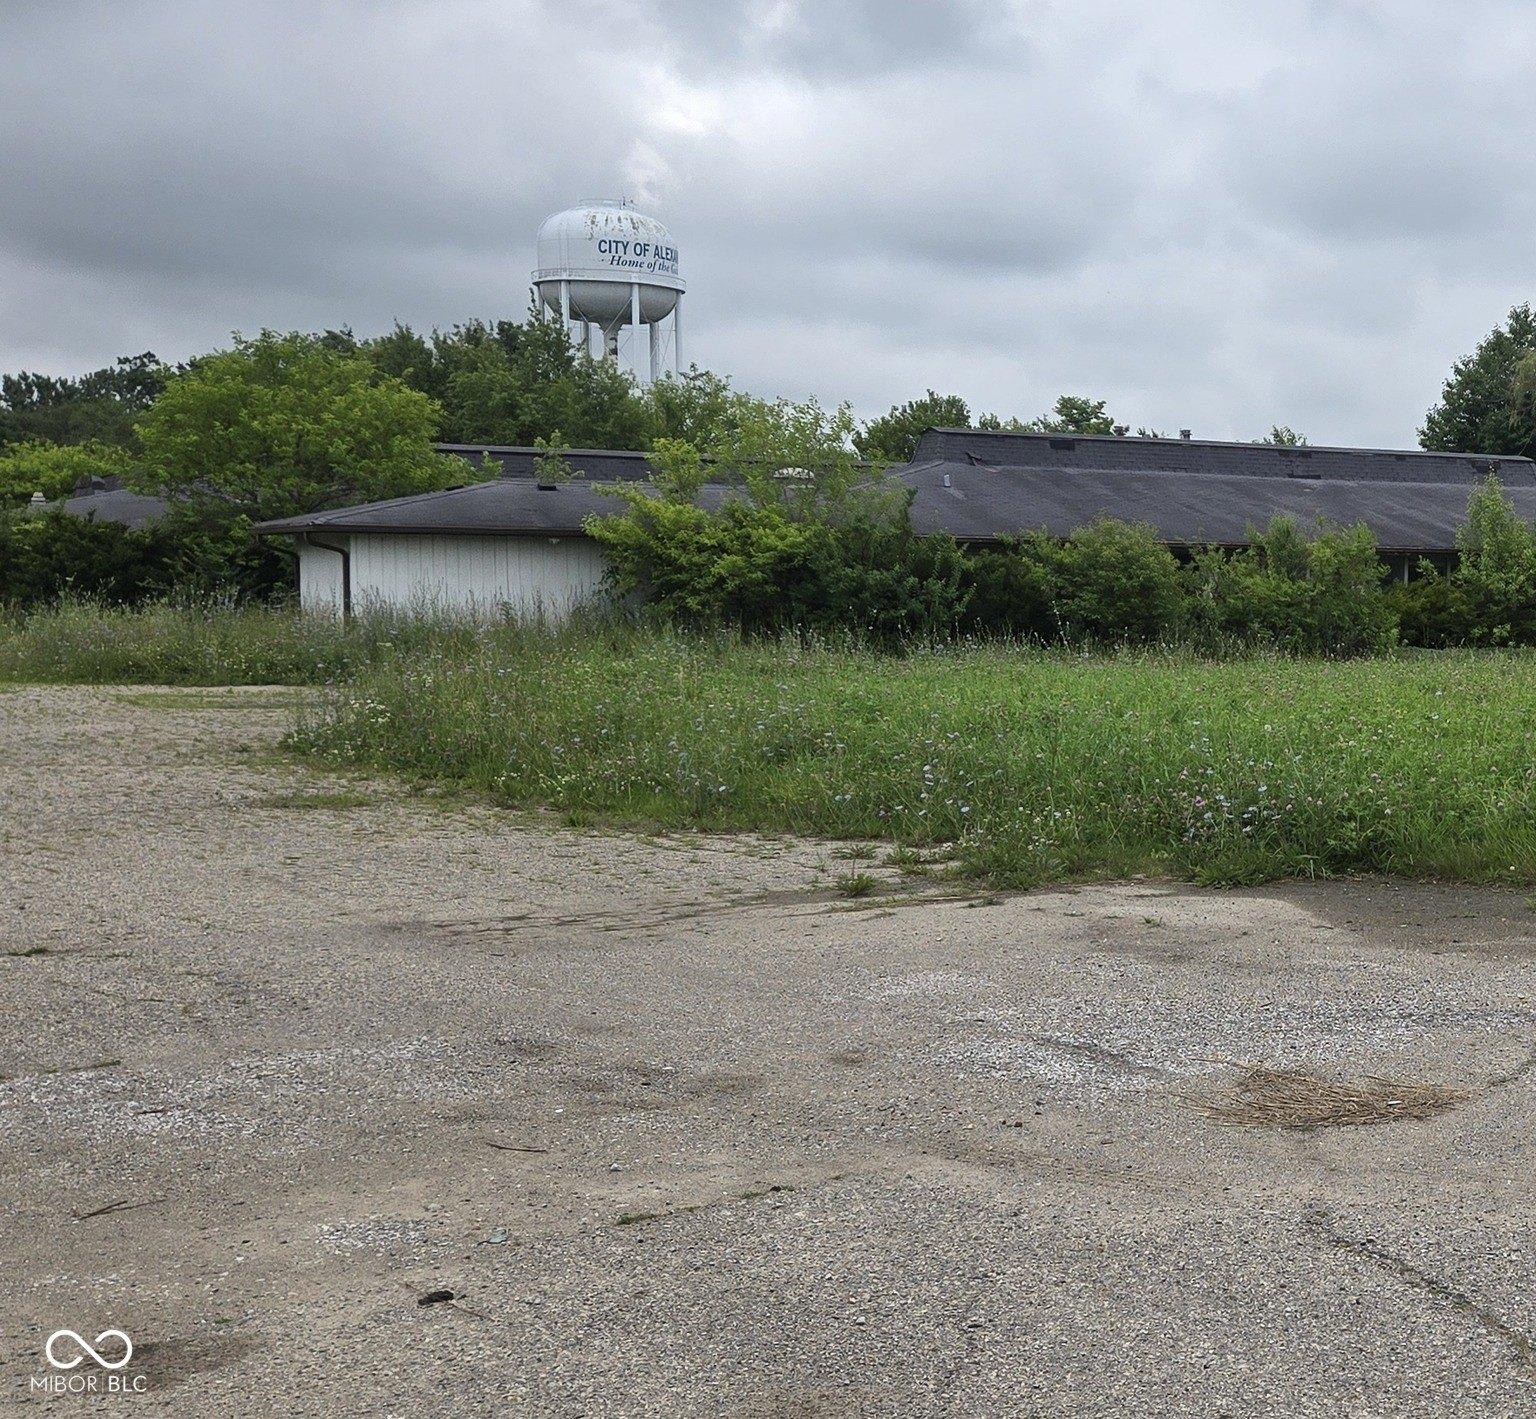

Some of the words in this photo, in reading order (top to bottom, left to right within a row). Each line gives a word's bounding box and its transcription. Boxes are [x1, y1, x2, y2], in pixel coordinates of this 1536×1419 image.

[598, 239, 630, 255] CITY
[633, 242, 650, 257] OF
[610, 255, 645, 268] Home
[647, 259, 659, 273] of
